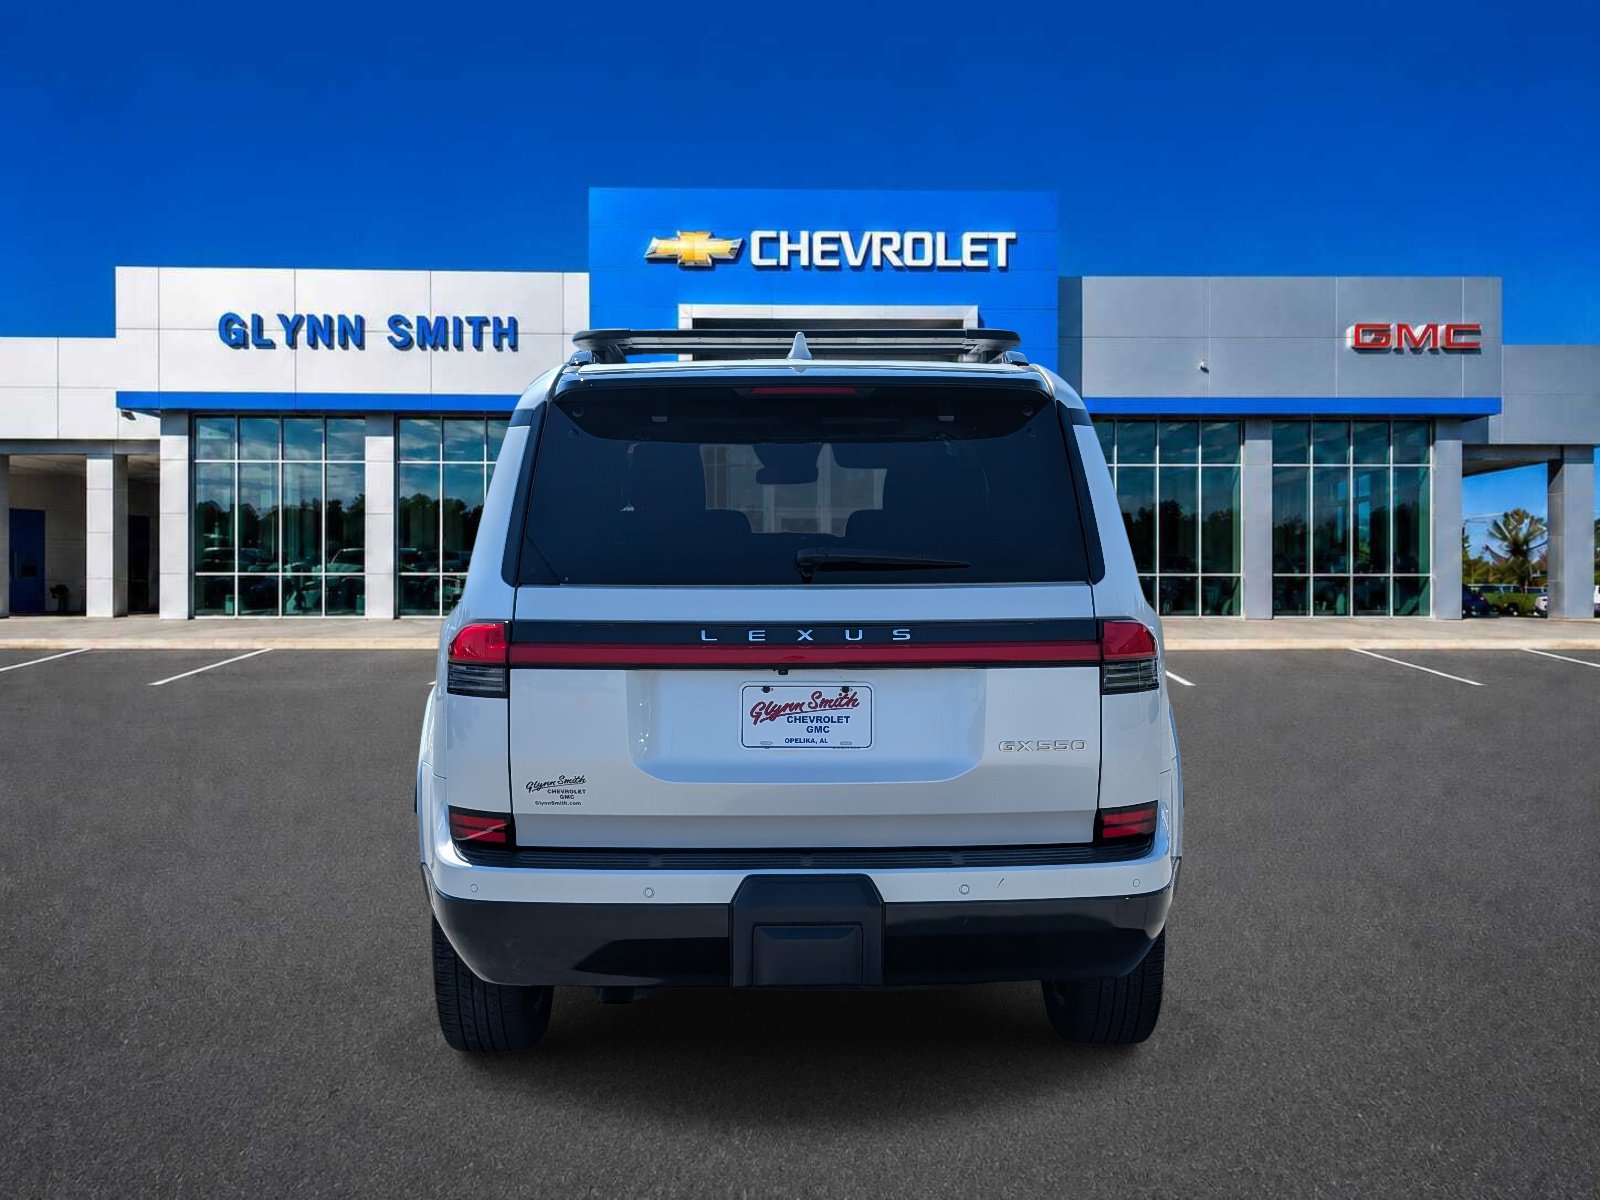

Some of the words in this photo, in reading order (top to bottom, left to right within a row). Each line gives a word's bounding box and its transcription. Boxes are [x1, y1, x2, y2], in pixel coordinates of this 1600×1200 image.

[751, 230, 1017, 268] CHEVROLET
[218, 312, 365, 350] GLYNN
[387, 314, 519, 351] SMITH
[1348, 322, 1482, 352] GMC
[701, 628, 911, 641] LEXUS
[749, 700, 805, 725] Glynn
[807, 690, 860, 709] Smith
[786, 715, 851, 724] CHEVROLET
[806, 725, 830, 734] GMC
[525, 780, 556, 793] Glynn
[557, 774, 587, 785] Smith
